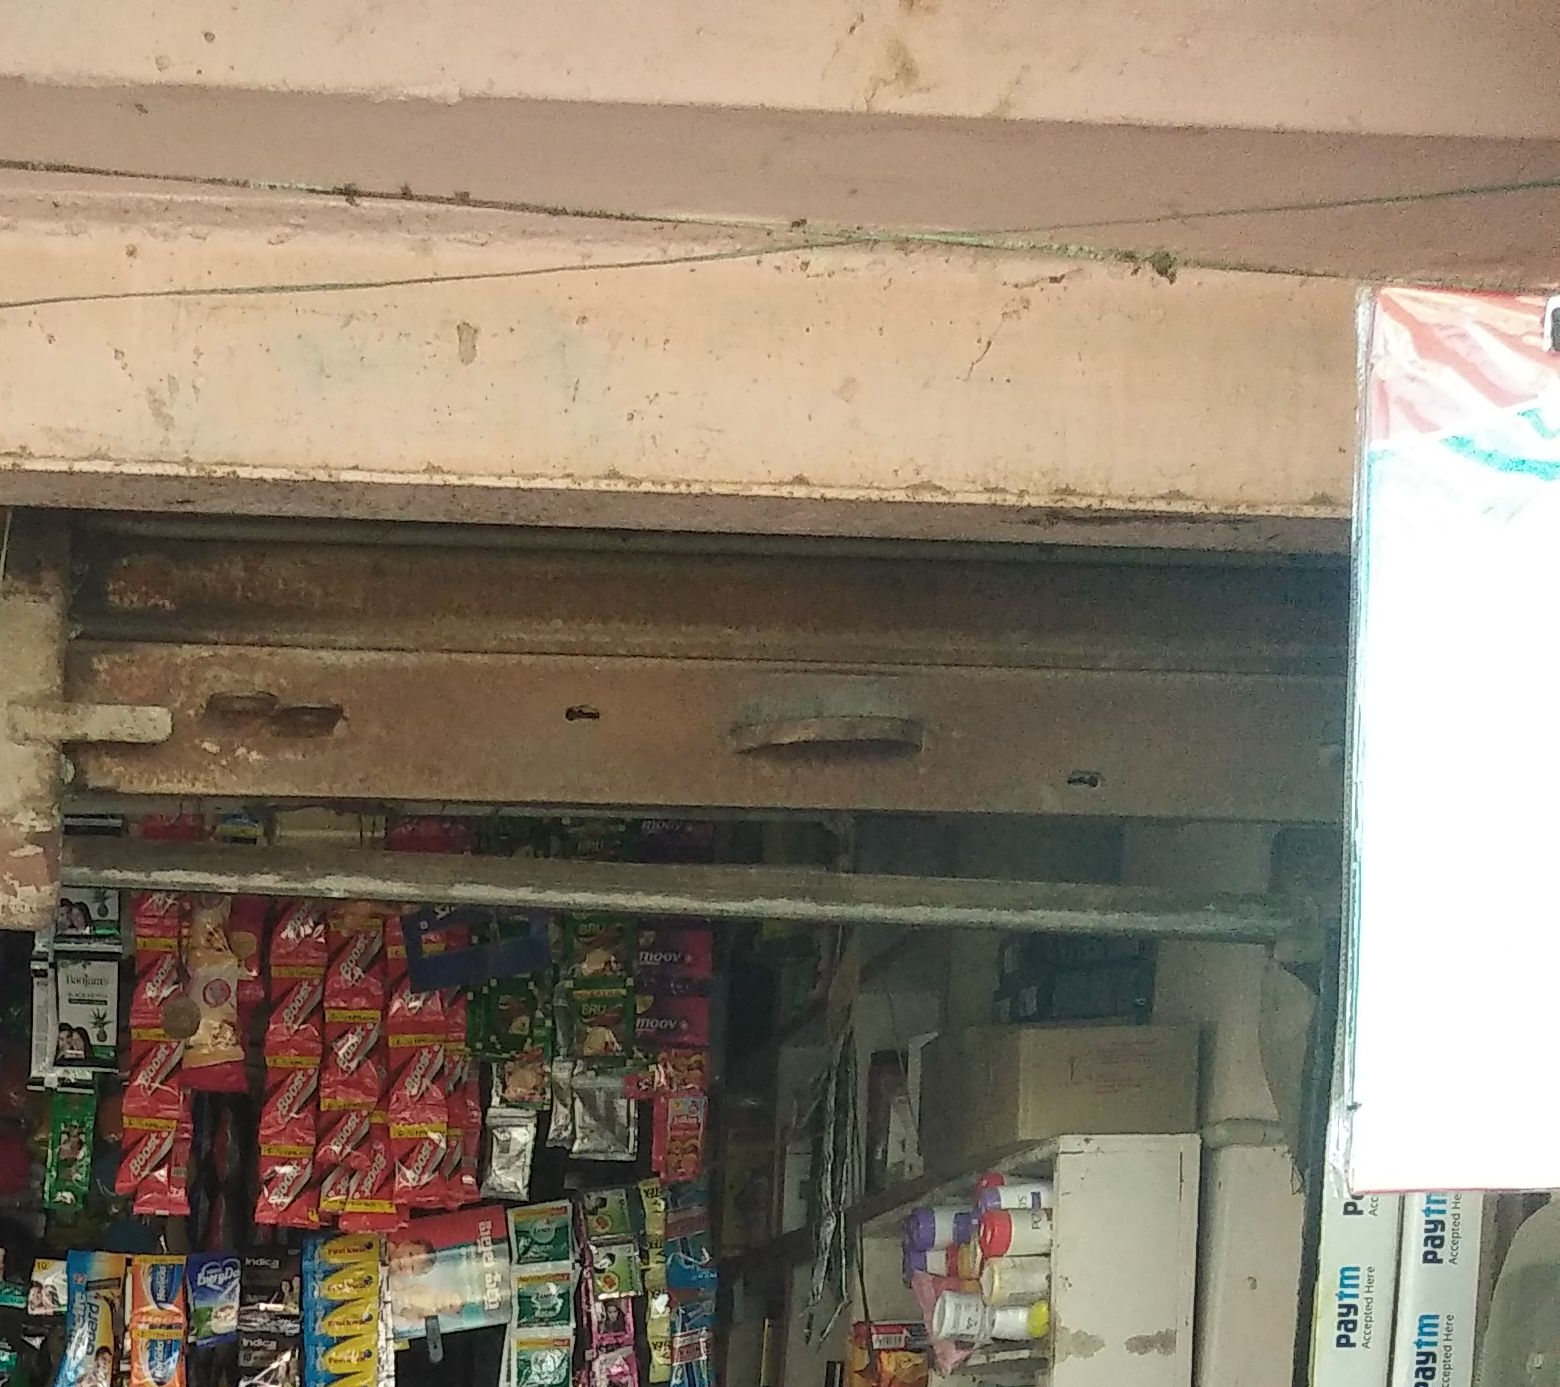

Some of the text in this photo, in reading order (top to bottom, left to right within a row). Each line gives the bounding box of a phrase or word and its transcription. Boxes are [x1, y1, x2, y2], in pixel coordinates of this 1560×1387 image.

[638, 950, 681, 963] moov
[635, 1018, 679, 1030] moov
[277, 1068, 305, 1112] Boost
[129, 1131, 160, 1175] Boost
[1447, 1217, 1458, 1265] Accepted
[245, 1257, 280, 1268] Indica
[1335, 1265, 1361, 1349] Paytm
[243, 1338, 277, 1349] Indica
